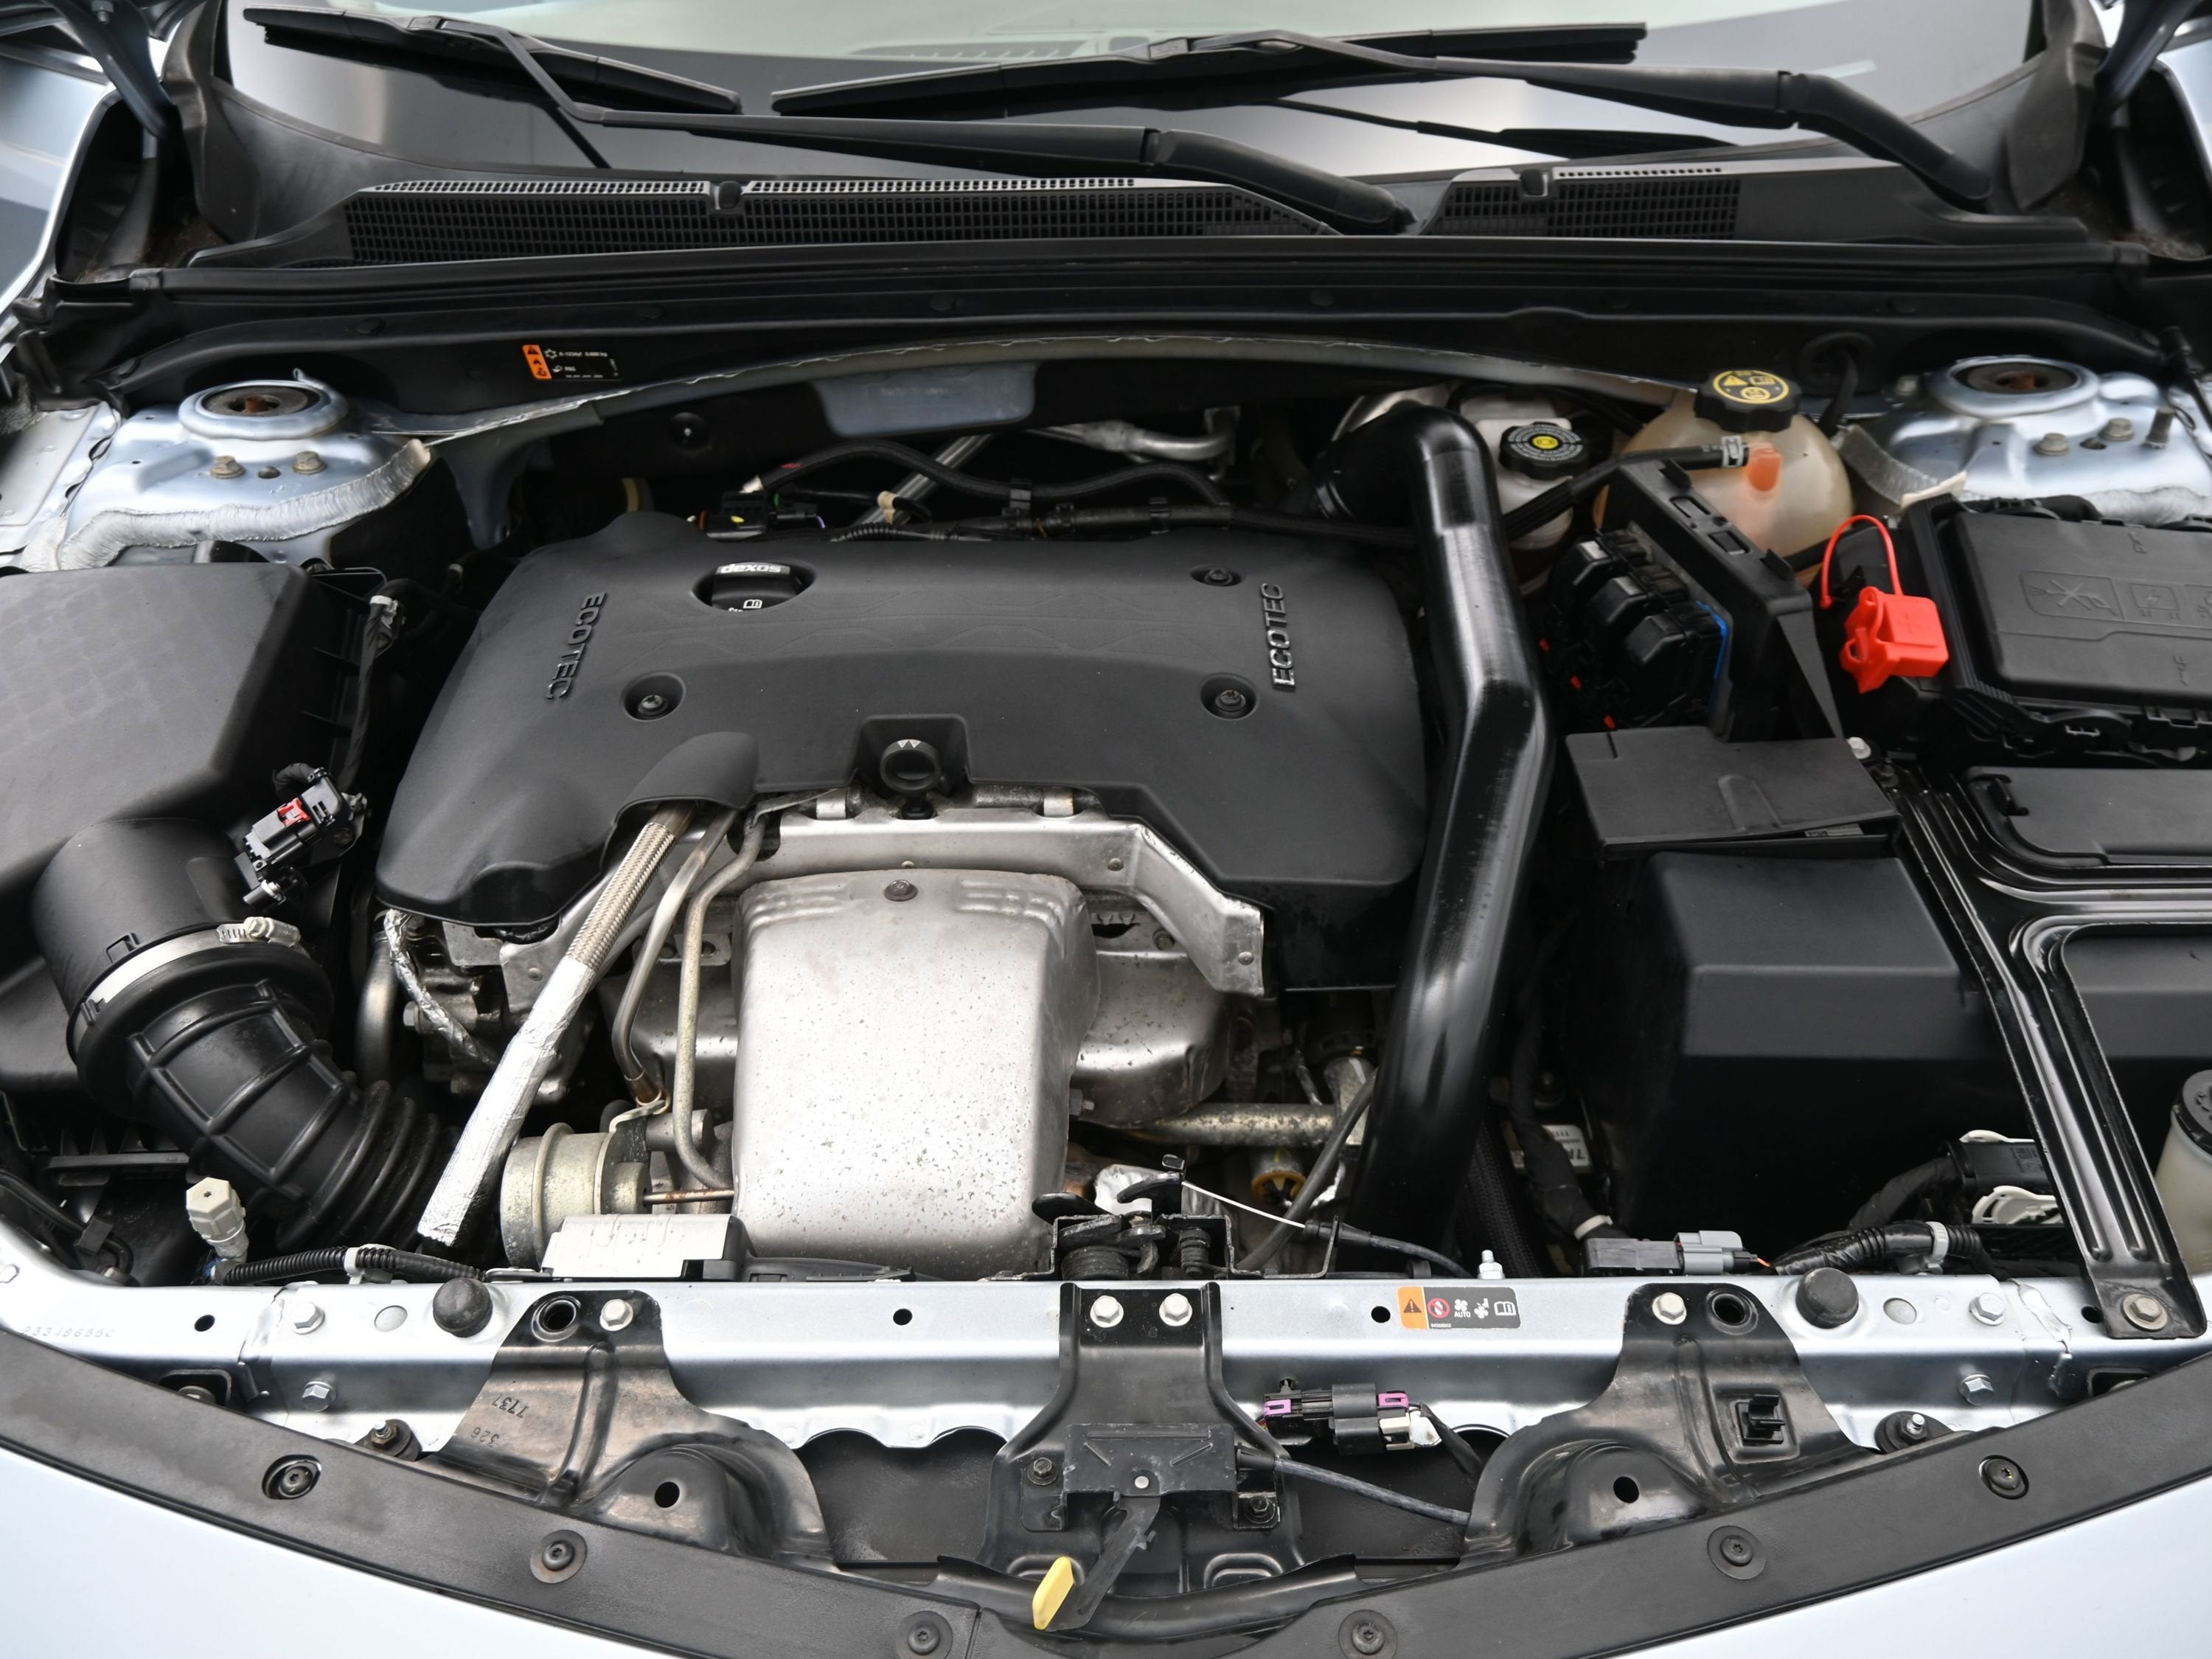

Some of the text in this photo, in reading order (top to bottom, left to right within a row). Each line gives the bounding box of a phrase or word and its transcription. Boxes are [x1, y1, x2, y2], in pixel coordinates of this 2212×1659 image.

[720, 563, 781, 574] dexos
[546, 591, 607, 700] ECOTEC
[1261, 582, 1295, 689] ECOTEC
